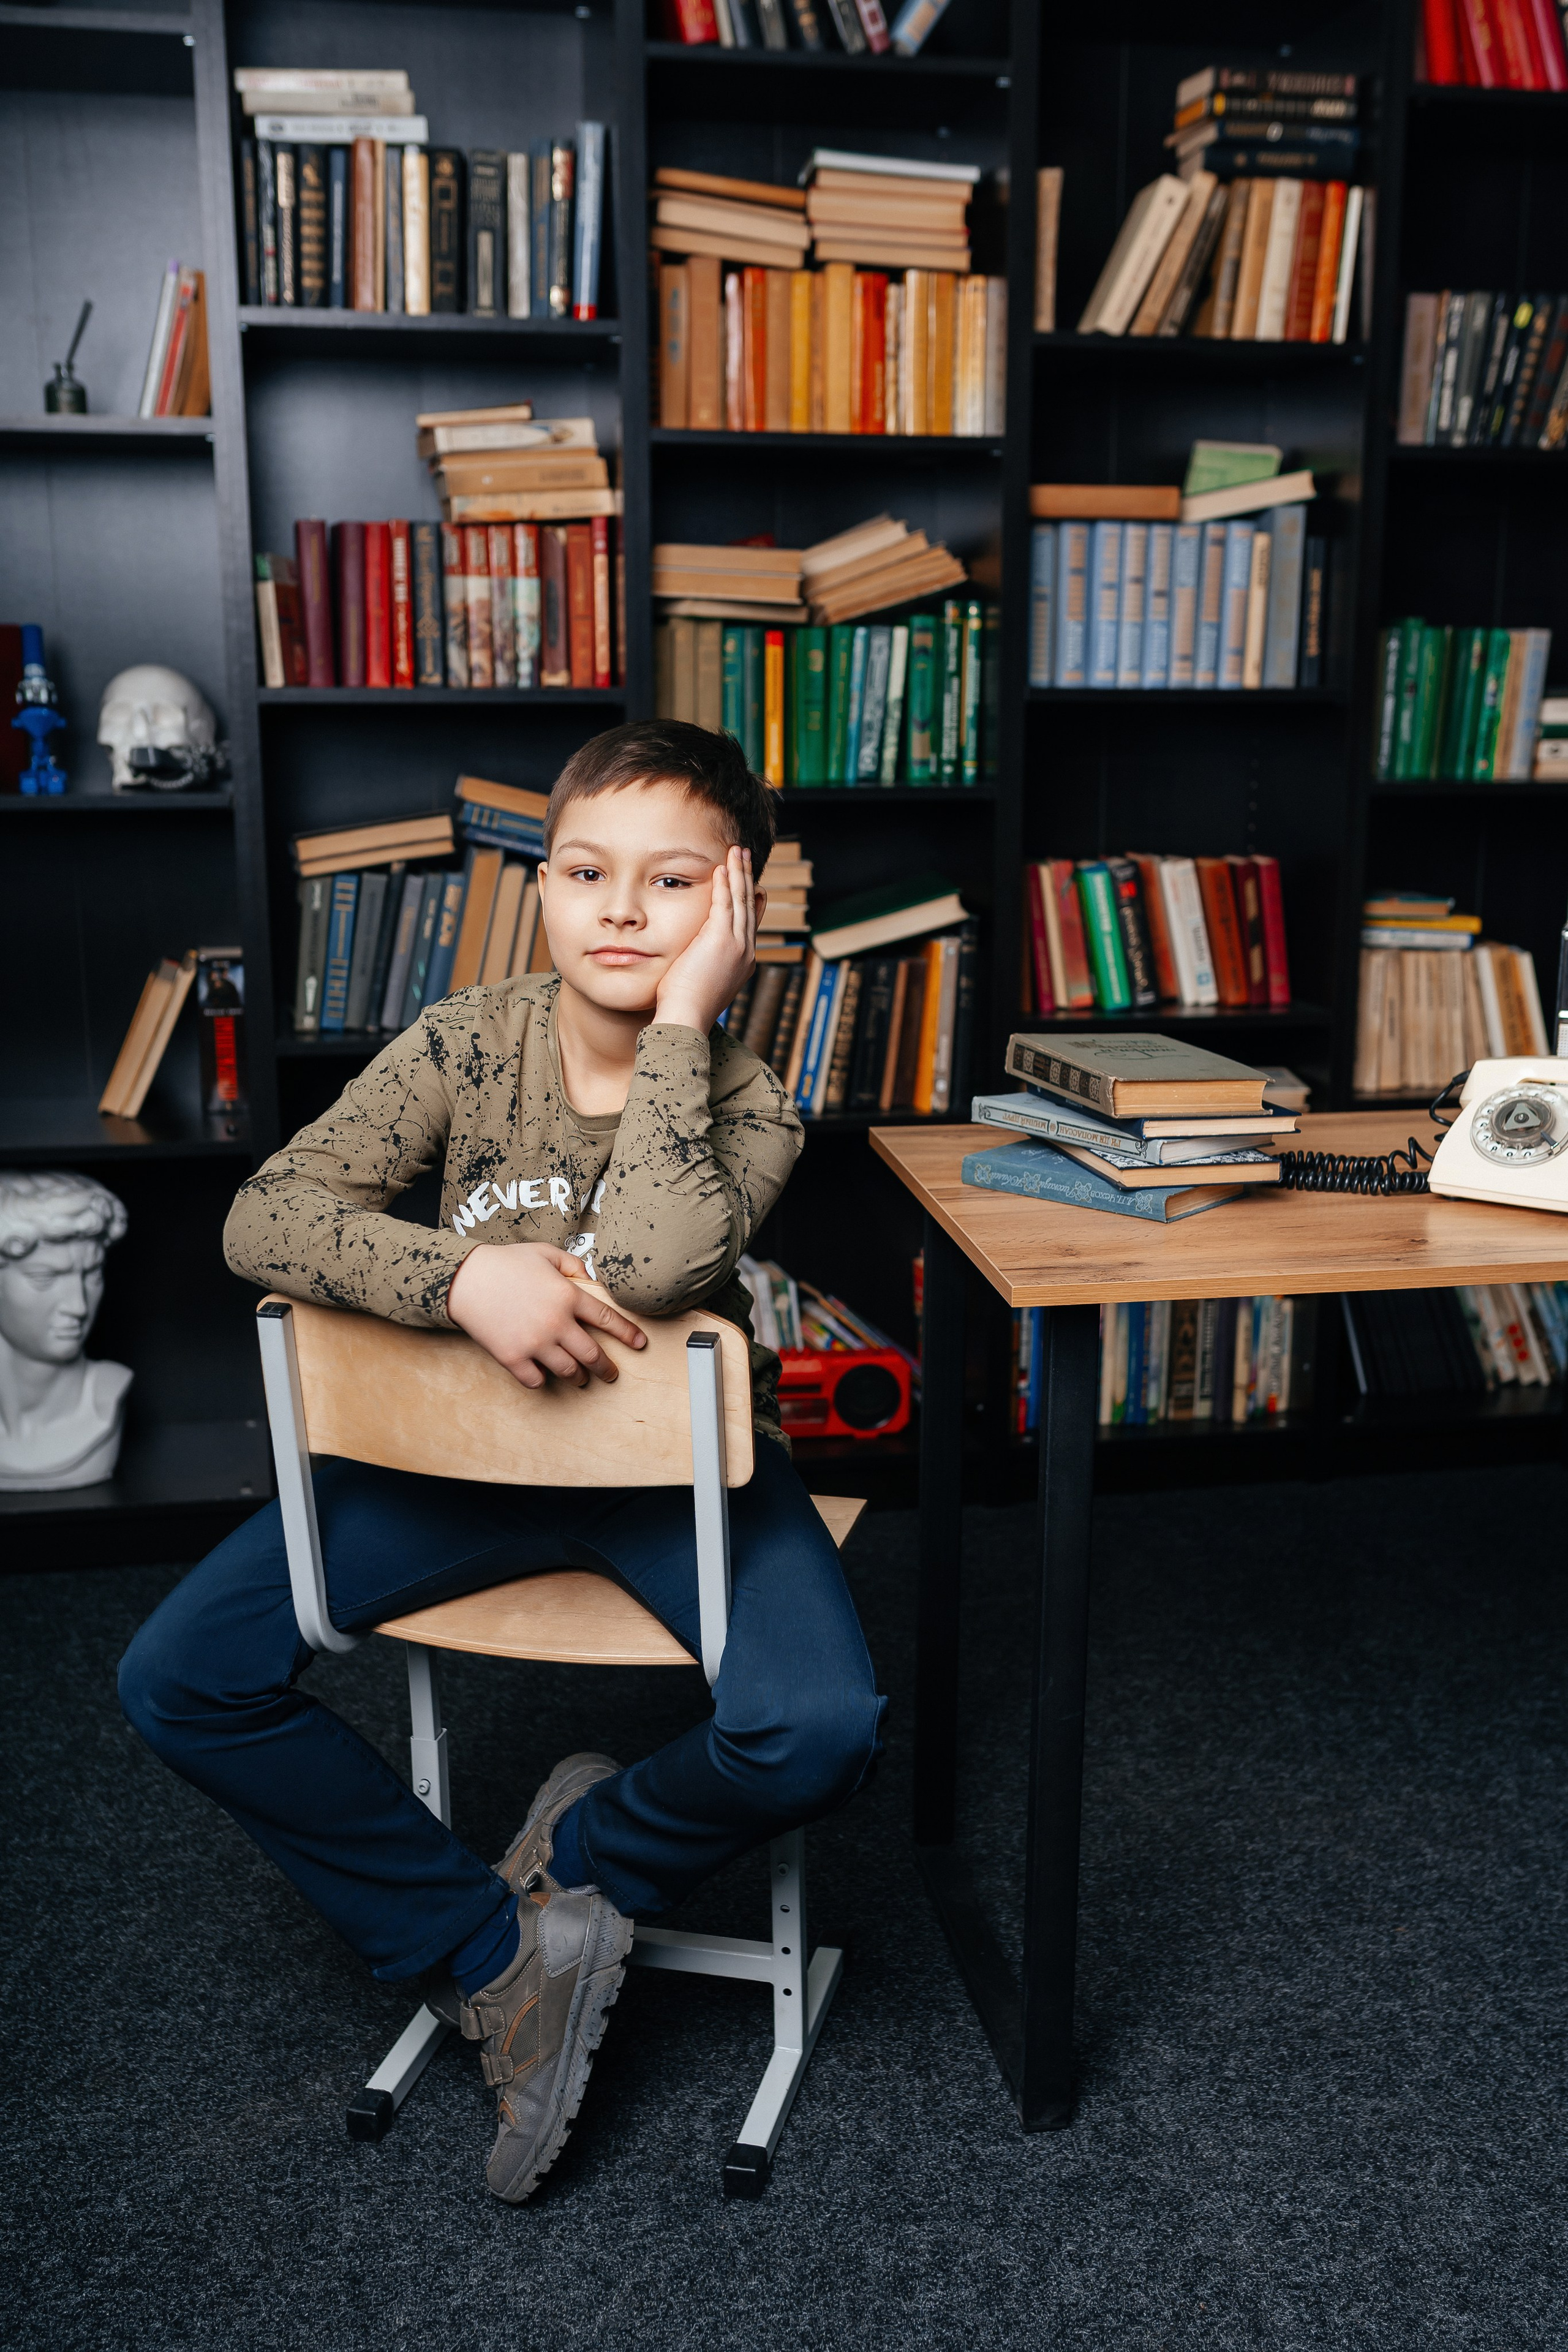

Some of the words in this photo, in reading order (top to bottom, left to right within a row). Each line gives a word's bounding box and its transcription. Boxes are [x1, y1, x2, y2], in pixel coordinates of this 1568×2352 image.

[1002, 1112, 1020, 1123] ДРУГ
[1020, 1118, 1046, 1130] МИЛЫЙ
[1059, 1126, 1099, 1141] МОПАССАН
[452, 1177, 571, 1237] NEVER
